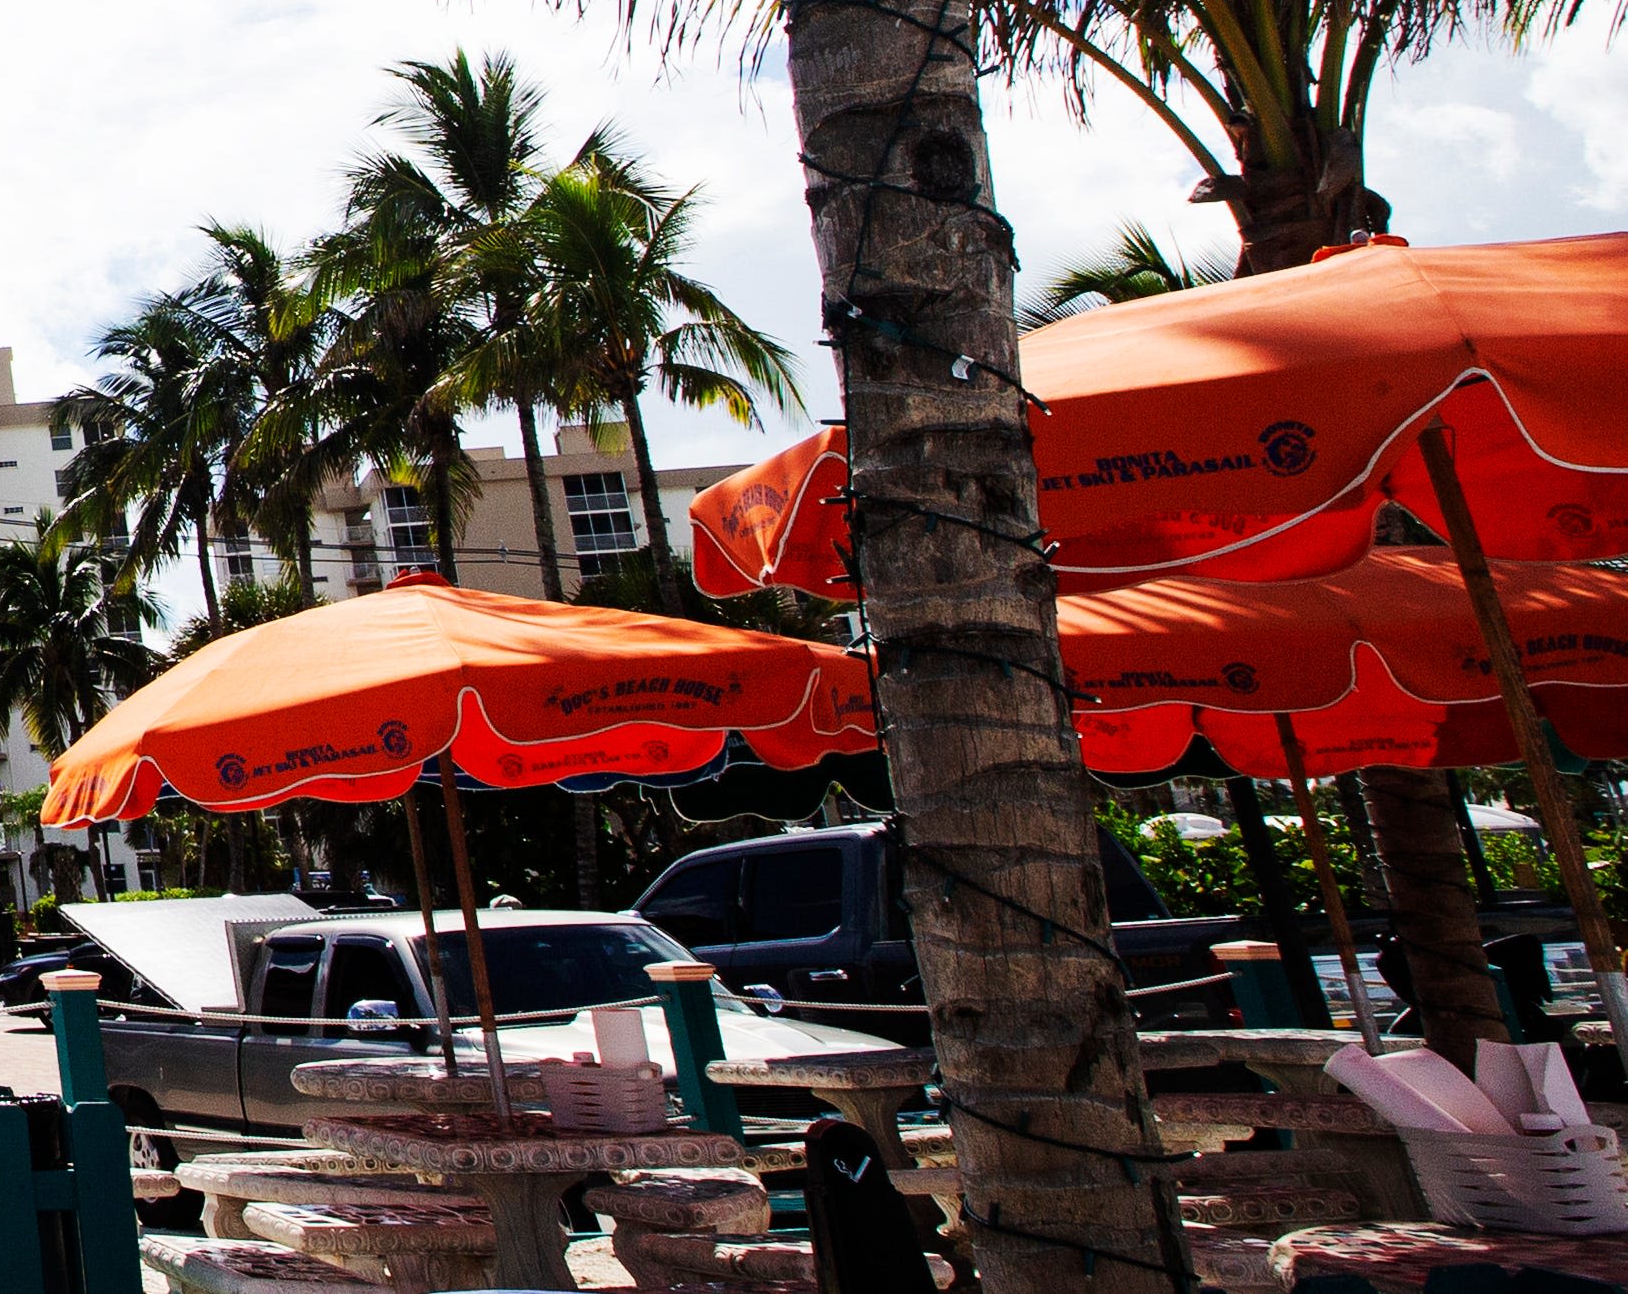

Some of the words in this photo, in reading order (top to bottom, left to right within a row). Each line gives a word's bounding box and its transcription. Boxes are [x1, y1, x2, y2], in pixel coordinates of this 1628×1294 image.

[1040, 475, 1074, 492] JET
[1077, 471, 1115, 488] SKI
[1119, 467, 1137, 484] &
[1142, 453, 1258, 481] PARASAIL
[1094, 449, 1180, 474] BONITA
[560, 685, 610, 716] DOC'S
[615, 676, 673, 697] BEACH
[673, 677, 725, 706] HOUSE
